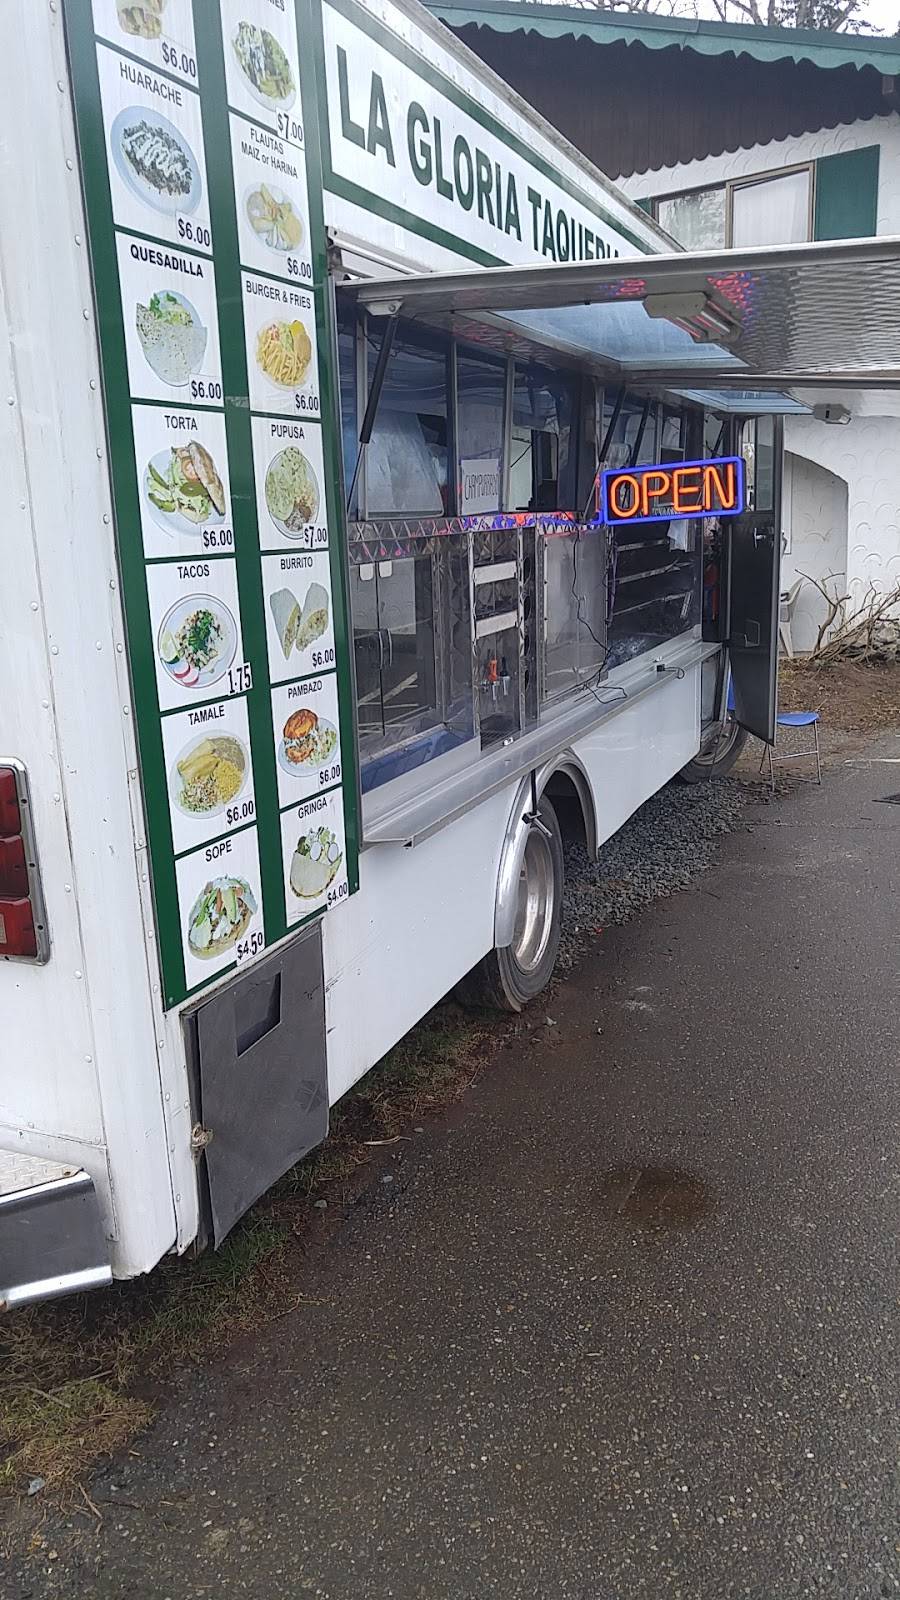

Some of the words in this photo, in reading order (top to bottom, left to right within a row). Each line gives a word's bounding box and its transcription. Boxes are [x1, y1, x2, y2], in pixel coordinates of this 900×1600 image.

[162, 42, 196, 78] $6.00
[119, 62, 183, 107] HUARACHE
[277, 114, 303, 142] $7.00
[250, 128, 284, 155] FLAUTAS
[336, 44, 396, 168] LA
[406, 100, 522, 242] GLORIA
[527, 186, 620, 262] TAQUE
[241, 141, 259, 160] MAIZ
[261, 153, 269, 164] or
[271, 155, 298, 178] HARINA
[178, 218, 211, 247] $6.00
[130, 244, 204, 278] QUESADILLA
[287, 257, 312, 279] $6.00
[246, 280, 280, 302] BURGER
[282, 290, 288, 303] &
[289, 291, 311, 309] FRIES
[191, 380, 221, 400] $6.00
[295, 393, 319, 412] $6.00
[164, 415, 198, 431] TORTA
[271, 424, 305, 440] PUPUSA
[610, 463, 735, 518] OPEN
[203, 529, 233, 548] $6.00
[304, 524, 327, 548] $7.00
[177, 565, 210, 579] TACOS
[280, 556, 313, 570] BURRITO
[312, 647, 334, 668] $6.00
[288, 680, 323, 700] PAMBAZO
[188, 705, 225, 726] TAMALE
[320, 764, 341, 785] $6.00
[227, 800, 254, 824] $6.00
[298, 798, 327, 820] GRINGA
[205, 839, 233, 862] SOPE
[327, 883, 348, 906] $4.00
[237, 931, 263, 961] $4.50
